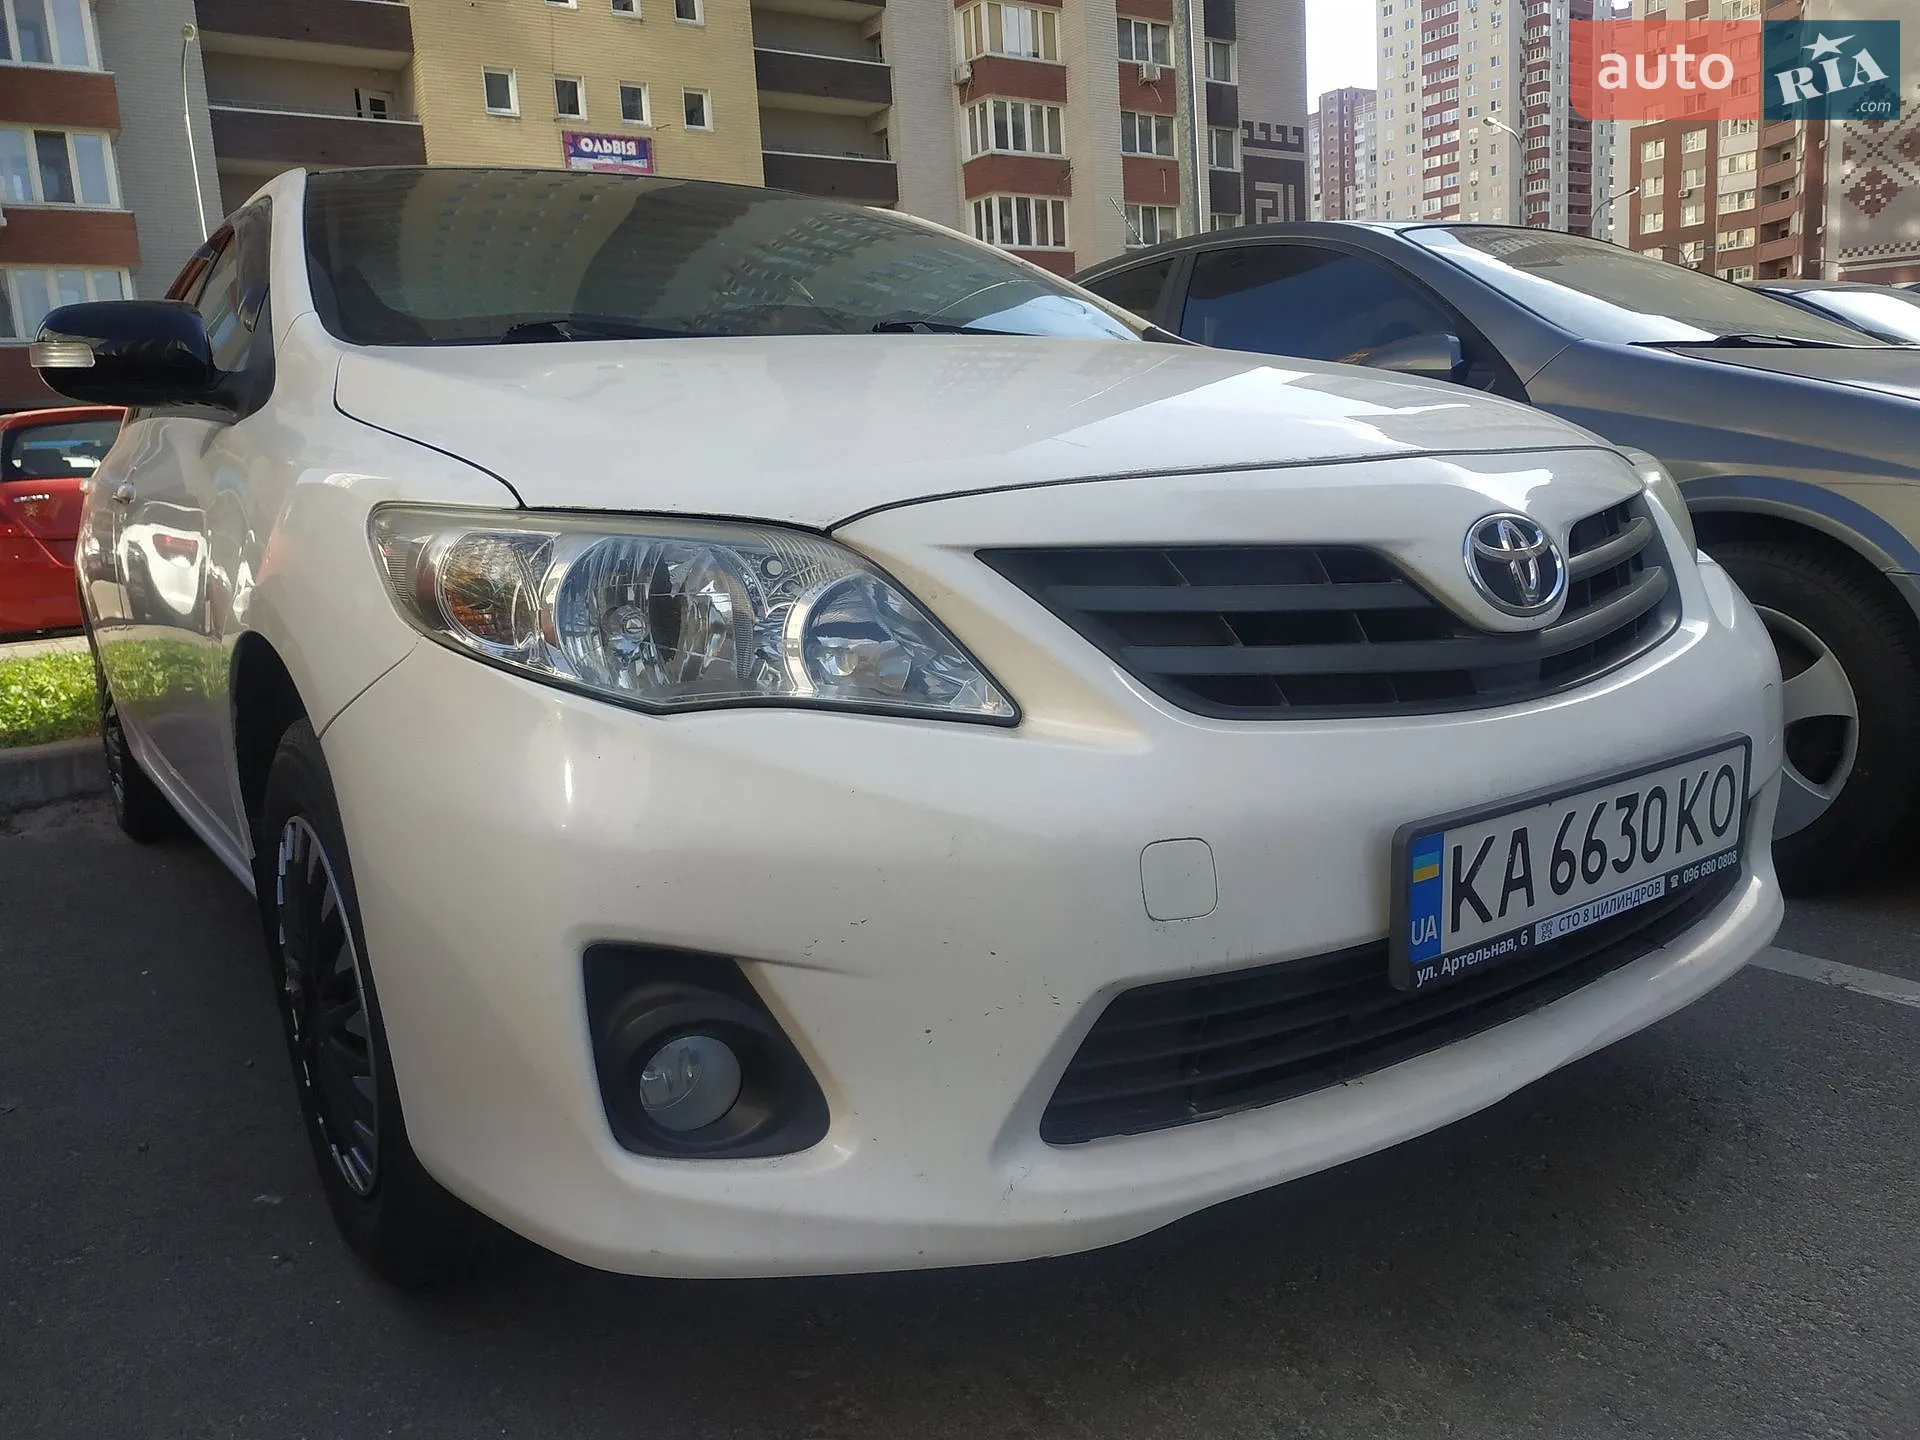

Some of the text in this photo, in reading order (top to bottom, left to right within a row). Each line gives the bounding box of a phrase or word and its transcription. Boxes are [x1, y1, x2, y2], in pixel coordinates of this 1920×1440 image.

[580, 138, 637, 156] ОЛЬВІЯ
[1549, 785, 1668, 897] 6630
[1411, 915, 1438, 946] UA
[1416, 966, 1438, 988] ул.
[1441, 937, 1518, 976] Артельная,
[1520, 929, 1529, 946] 6
[1558, 912, 1581, 932] СТО
[1583, 907, 1590, 922] 8
[1592, 882, 1661, 919] ЦИЛИНДРОВ
[1683, 865, 1700, 884] 096
[1701, 858, 1716, 877] 680
